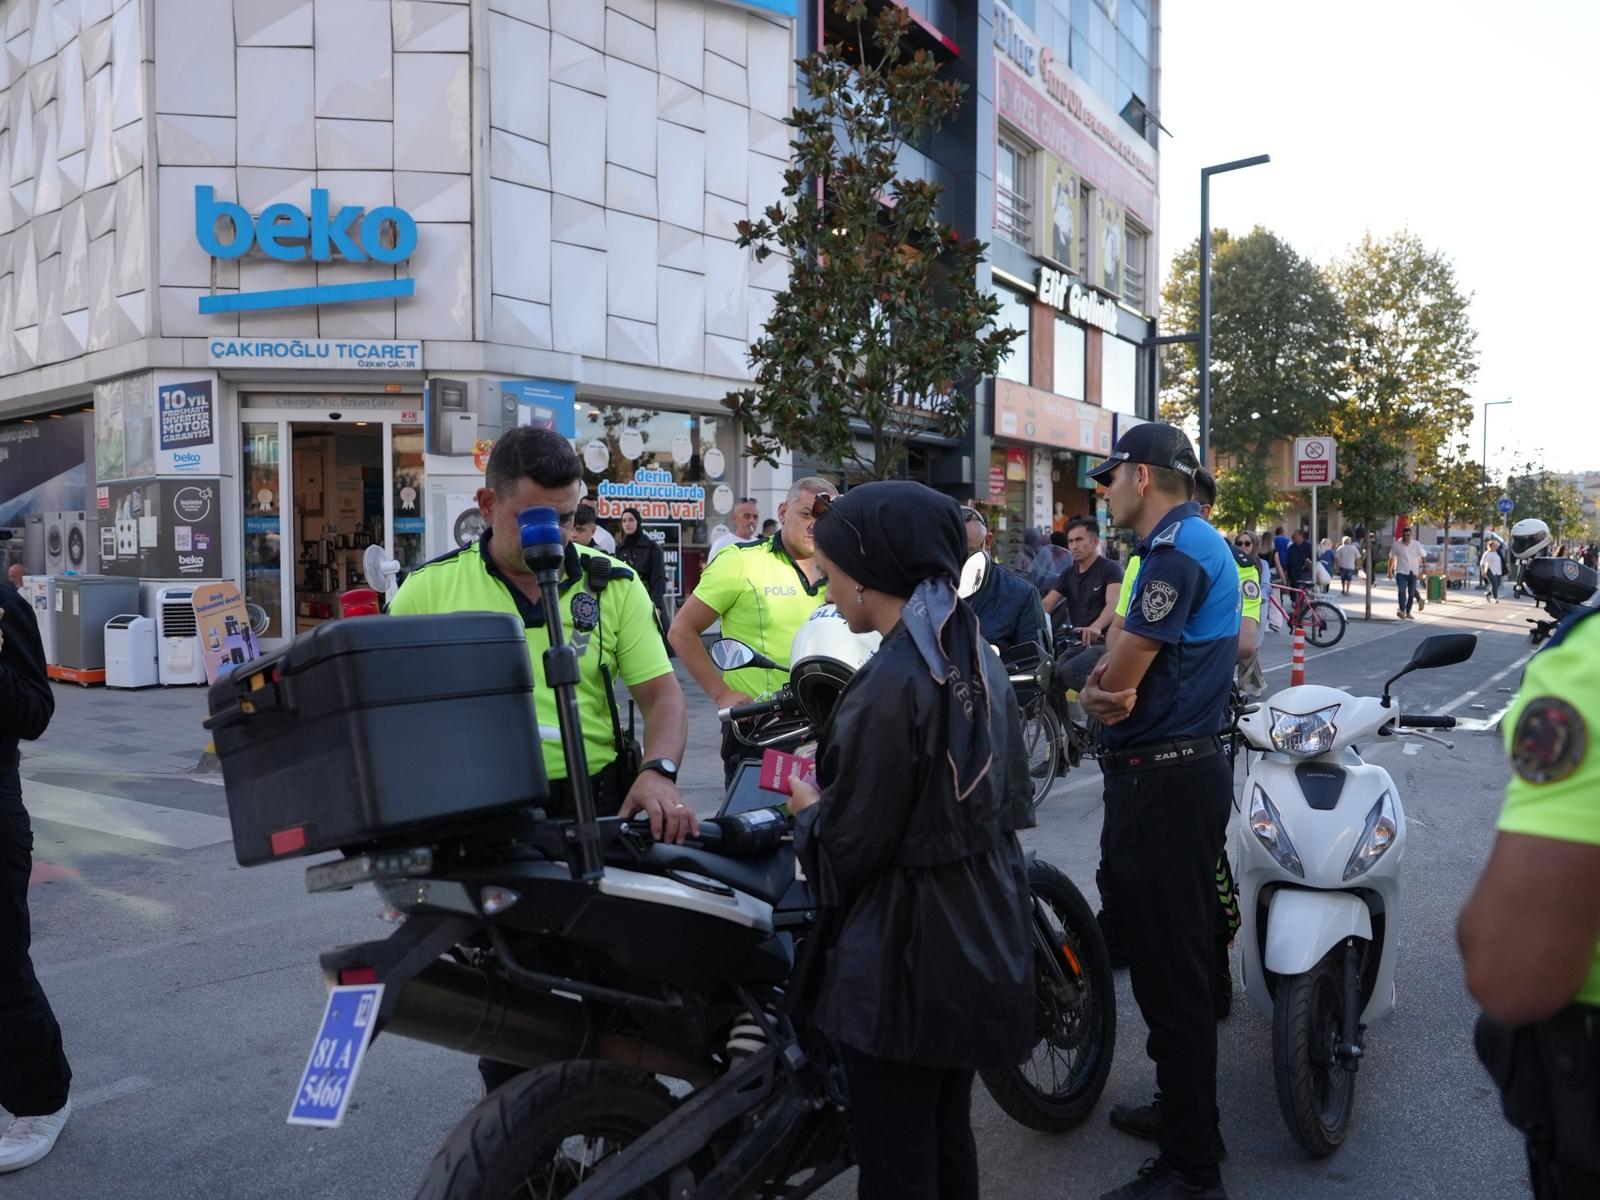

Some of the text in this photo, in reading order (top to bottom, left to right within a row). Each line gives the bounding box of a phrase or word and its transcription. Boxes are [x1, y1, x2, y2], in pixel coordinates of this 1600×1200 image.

[195, 184, 418, 264] beko
[210, 340, 419, 360] ÇAKIROĞLU TİCARET
[357, 360, 415, 369] Özkan ÇAKIR
[162, 390, 209, 410] 10 YIL
[276, 398, 321, 409] Çakıroğlu
[340, 398, 370, 408] Özkan
[162, 420, 210, 435] MOTOR
[163, 428, 210, 442] GARANTİSİ
[173, 452, 201, 462] beko
[636, 468, 671, 483] derin
[599, 481, 704, 499] dondurucularda
[670, 500, 704, 519] var!
[178, 555, 204, 564] beko
[1154, 747, 1194, 761] ZABTA
[313, 1037, 353, 1069] 81 A
[300, 1074, 347, 1108] 5466
